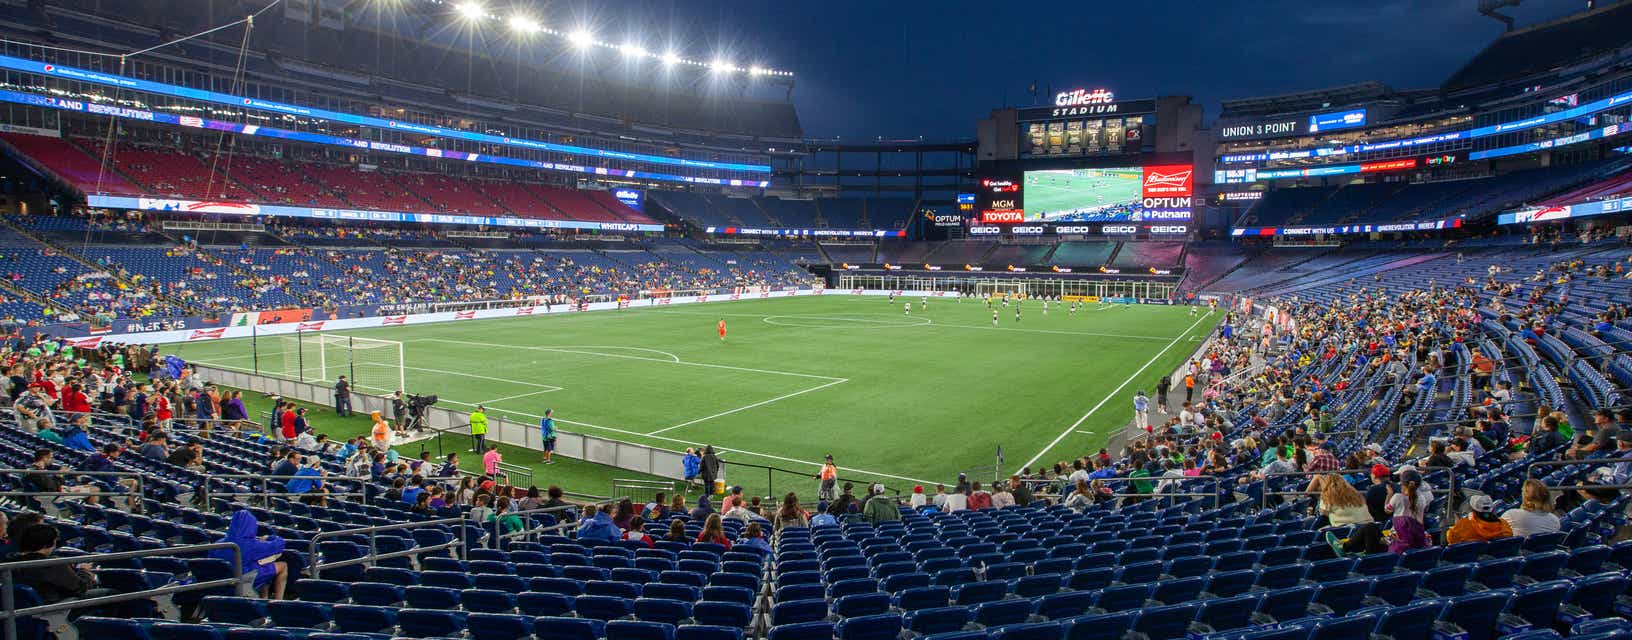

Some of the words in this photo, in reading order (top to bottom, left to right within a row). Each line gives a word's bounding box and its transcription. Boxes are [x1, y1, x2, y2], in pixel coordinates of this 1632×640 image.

[1056, 89, 1113, 107] Gillette
[88, 103, 154, 120] REVOLUTION
[1053, 105, 1118, 117] STADIUM
[1223, 125, 1254, 137] UNION
[1256, 124, 1263, 135] 3
[1265, 121, 1297, 134] POINT
[1426, 156, 1442, 166] Party
[992, 200, 1015, 208] MGM
[1143, 197, 1191, 208] OPTUM
[984, 212, 1023, 221] TOYOTA
[1151, 210, 1191, 219] Putnam
[600, 223, 638, 231] WHITECAPS
[970, 226, 1000, 234] GEICO
[1012, 226, 1043, 234] GEICO
[1056, 226, 1089, 234] GEICO
[1283, 227, 1311, 235] CONNECT
[1312, 227, 1326, 235] WITH
[1327, 226, 1335, 234] US
